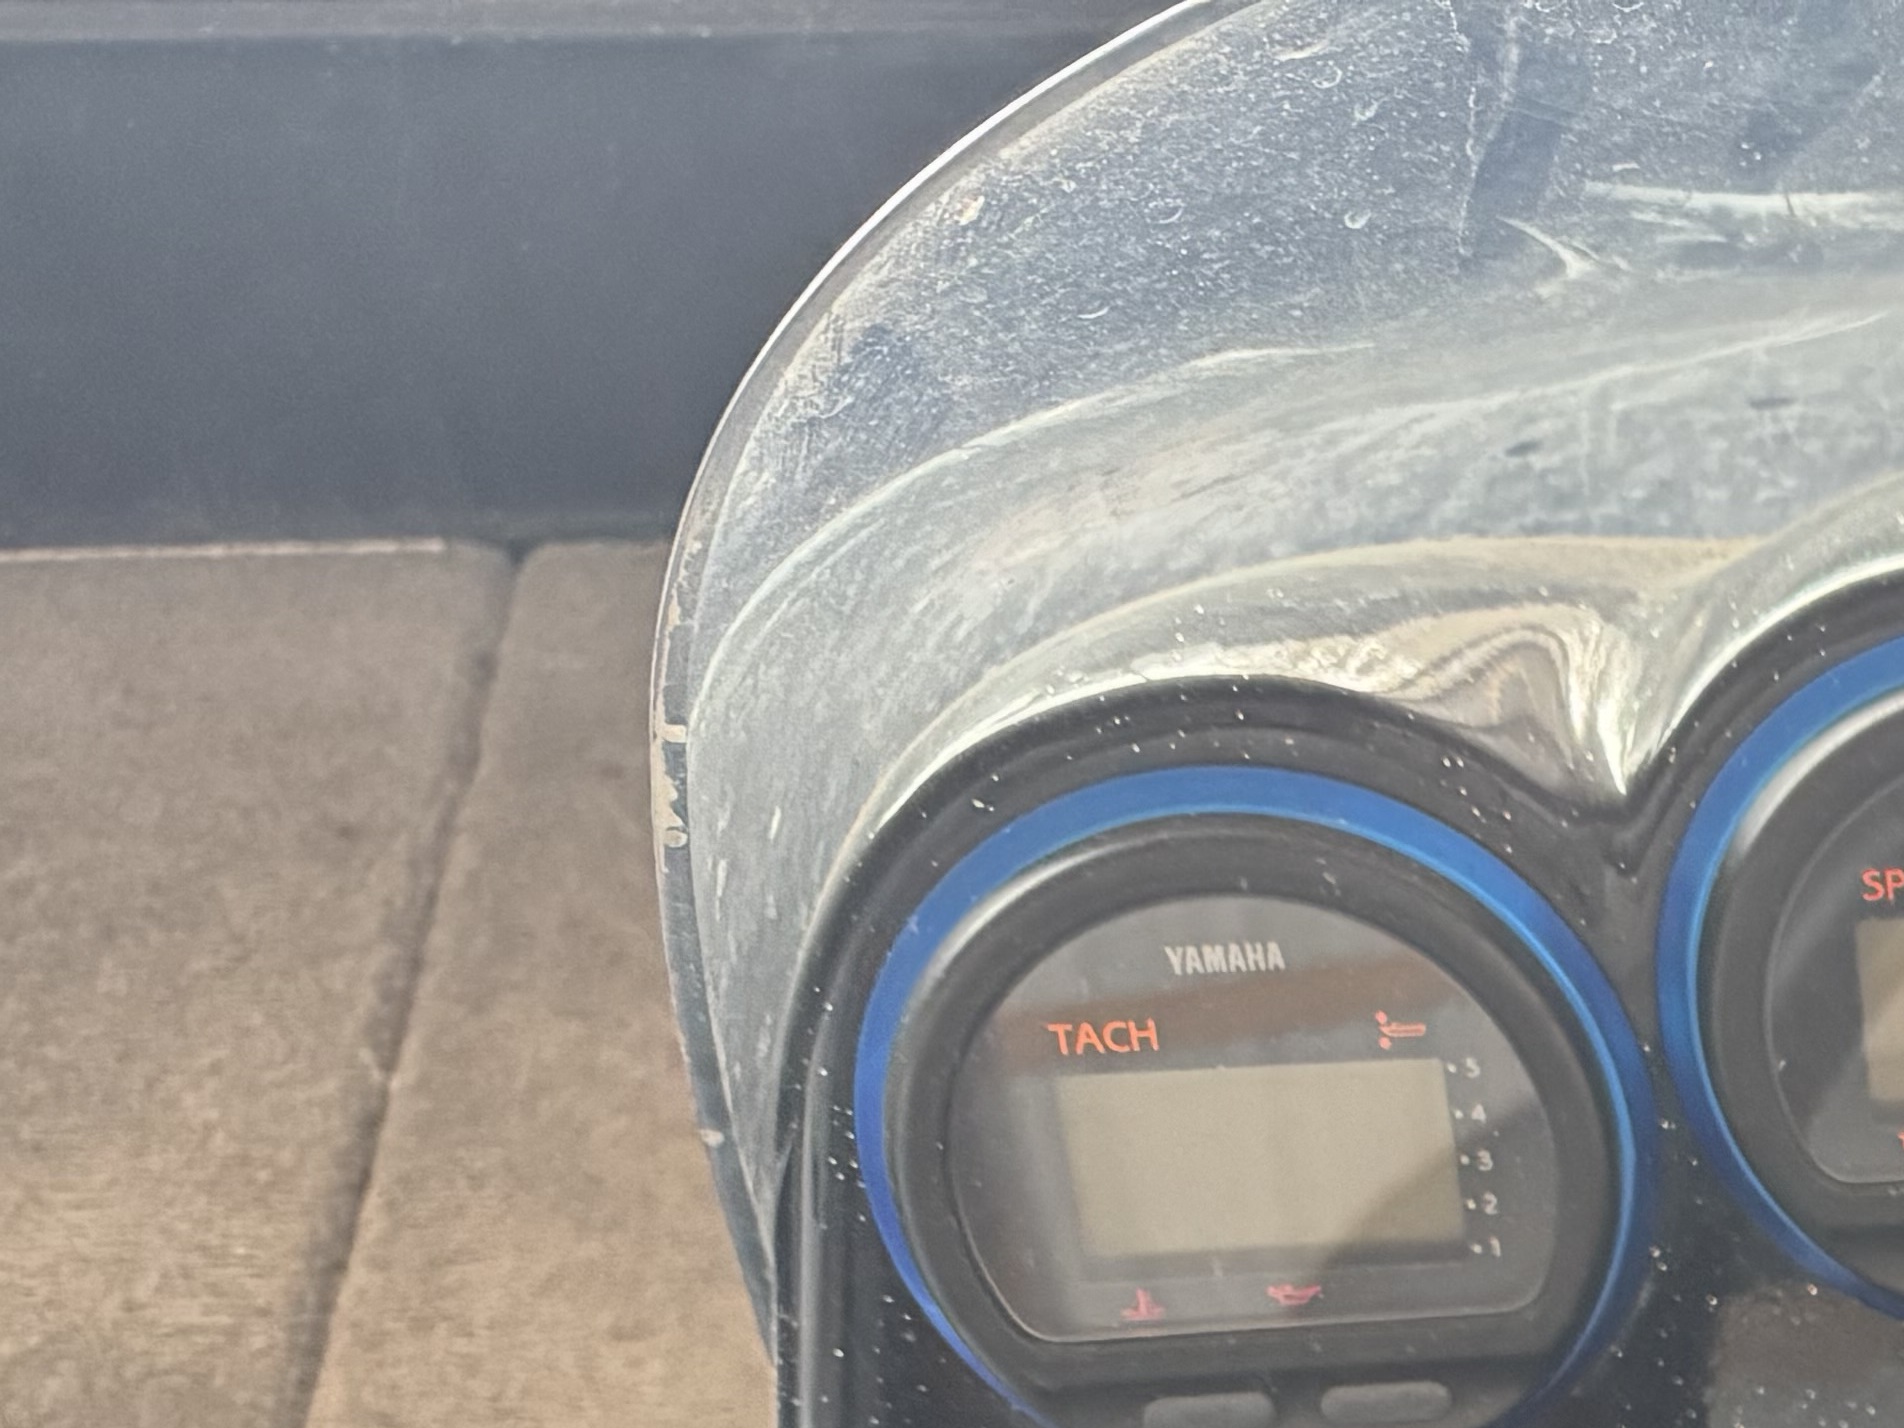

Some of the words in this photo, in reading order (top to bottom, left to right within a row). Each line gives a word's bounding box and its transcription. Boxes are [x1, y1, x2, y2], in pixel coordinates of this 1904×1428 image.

[1164, 940, 1286, 976] YAMAHA
[1048, 1018, 1159, 1056] TACH
[1465, 1056, 1481, 1079] 5
[1470, 1103, 1487, 1124] 4
[1476, 1149, 1494, 1172] 3
[1482, 1191, 1499, 1216] 2
